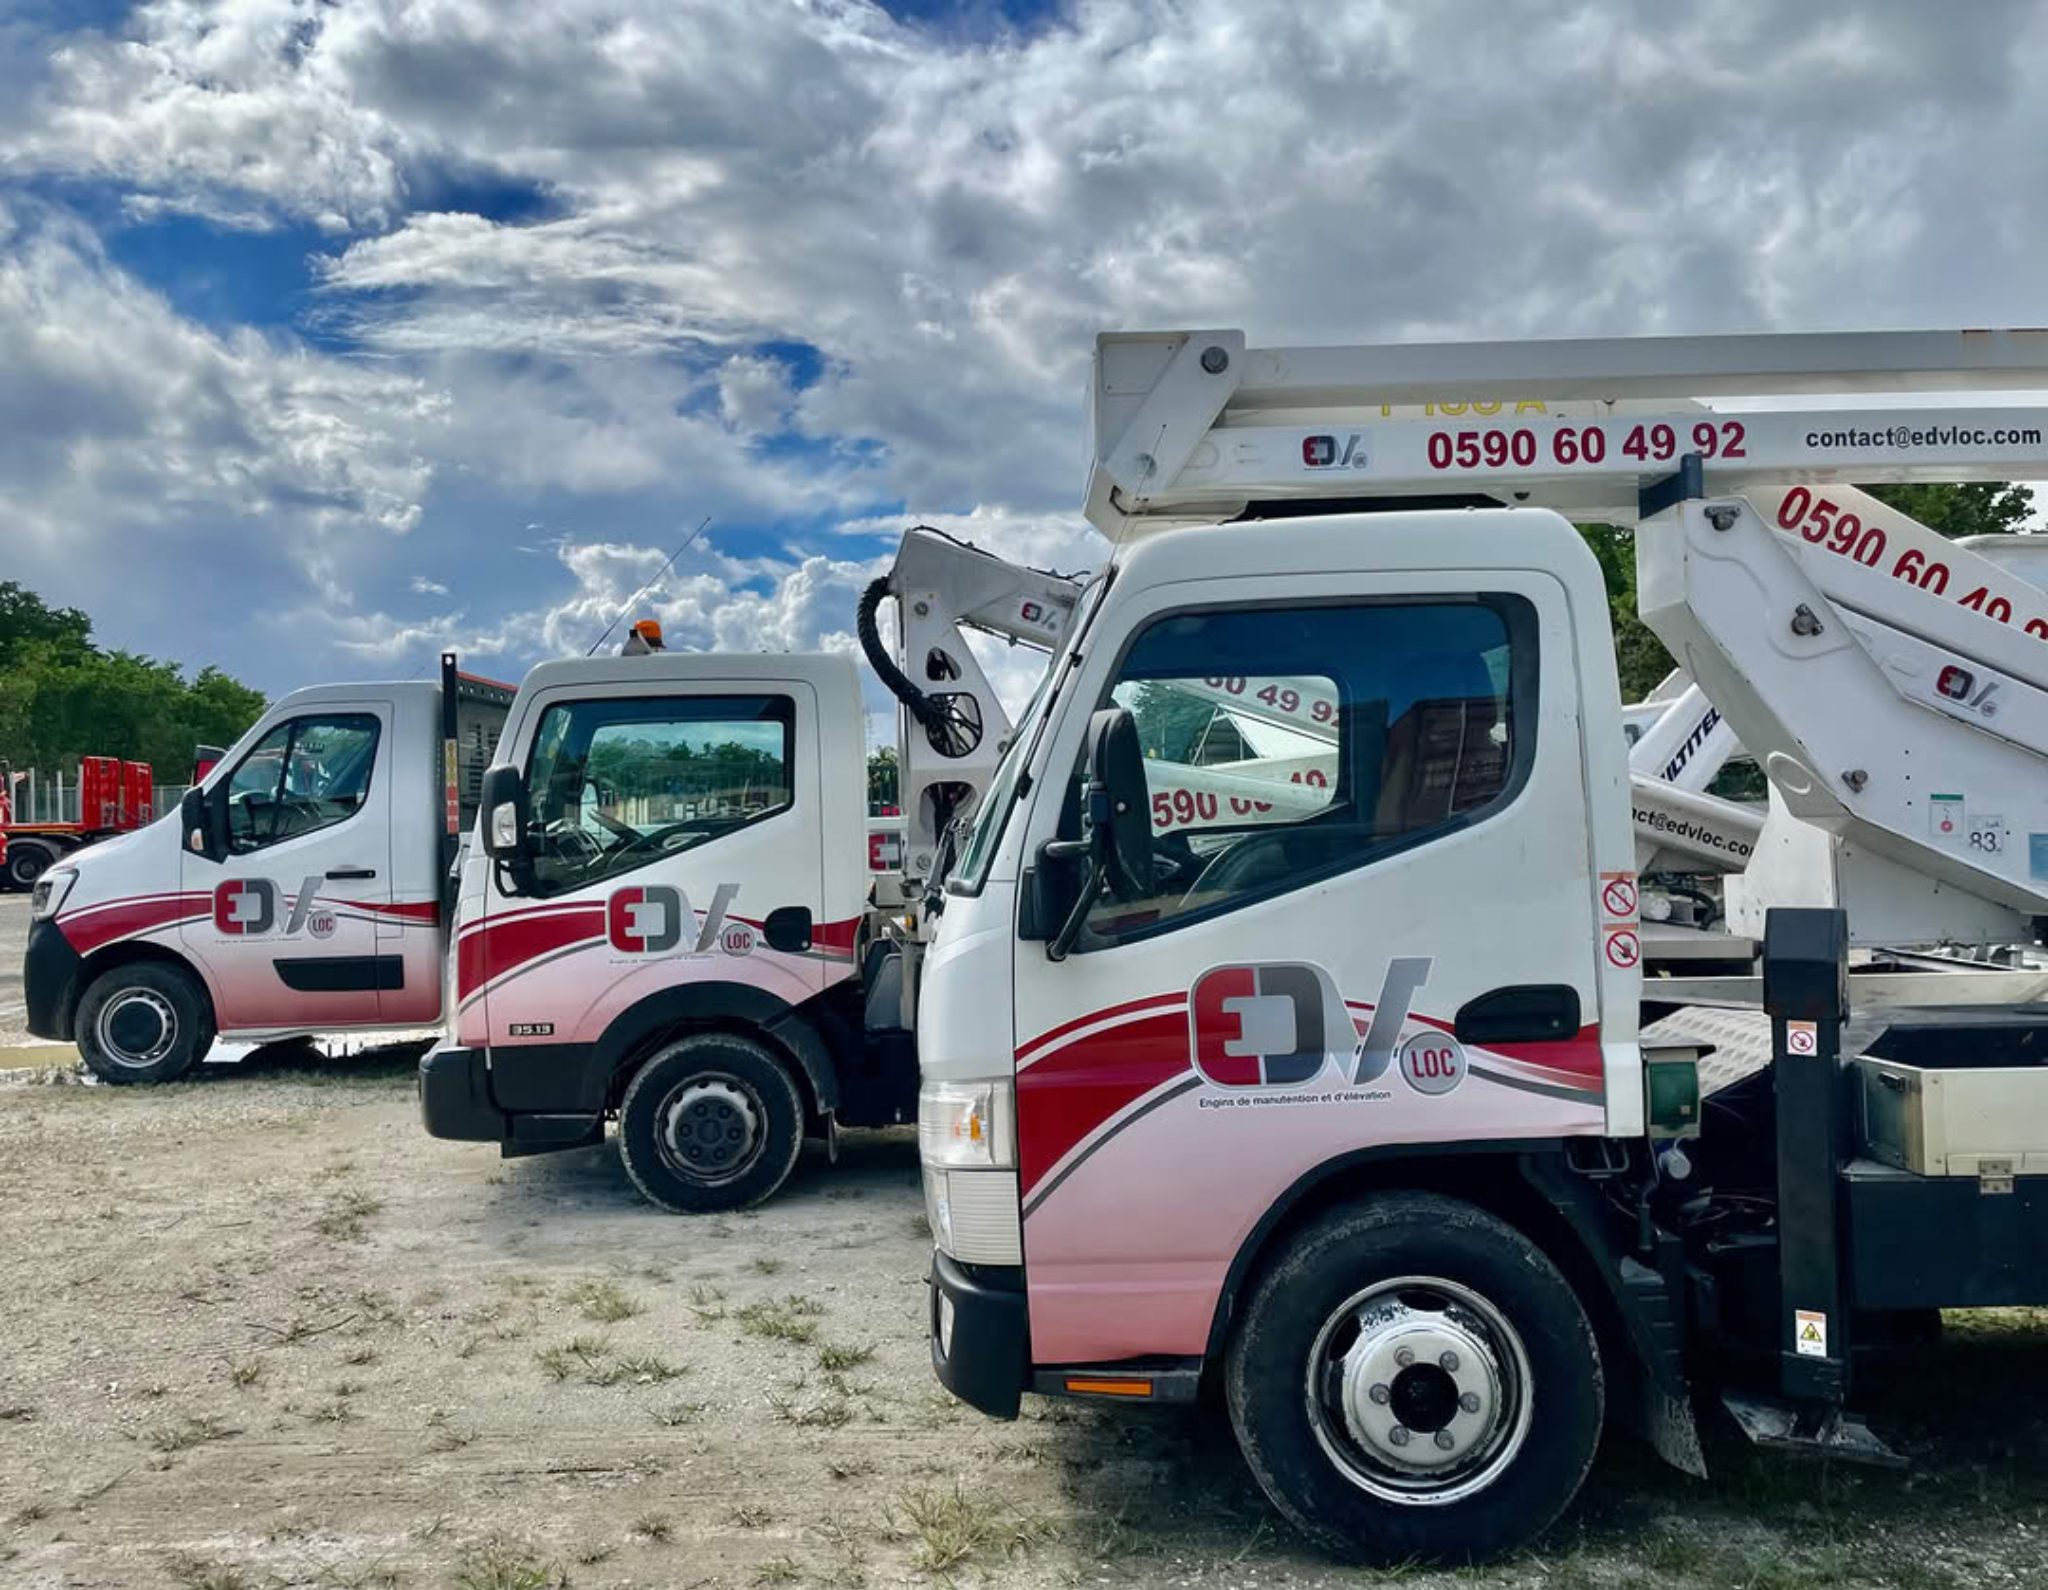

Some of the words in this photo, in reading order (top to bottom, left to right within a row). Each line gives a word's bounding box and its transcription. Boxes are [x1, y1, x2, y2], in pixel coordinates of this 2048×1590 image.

[1427, 430, 1537, 469] 0590
[1553, 427, 1605, 465] 60
[1622, 424, 1675, 461] 49
[1693, 421, 1746, 459] 92
[1806, 426, 2041, 449] contact@edvloc.com
[1777, 486, 1887, 568] 0590
[1257, 684, 1300, 712] 49
[1311, 701, 1339, 726] 9
[312, 918, 333, 932] LOC
[727, 932, 750, 949] LOC
[1411, 1048, 1456, 1078] LOC
[1199, 1098, 1235, 1110] Engins
[1237, 1096, 1251, 1106] de
[1253, 1093, 1318, 1105] manutention
[1321, 1093, 1332, 1102] et
